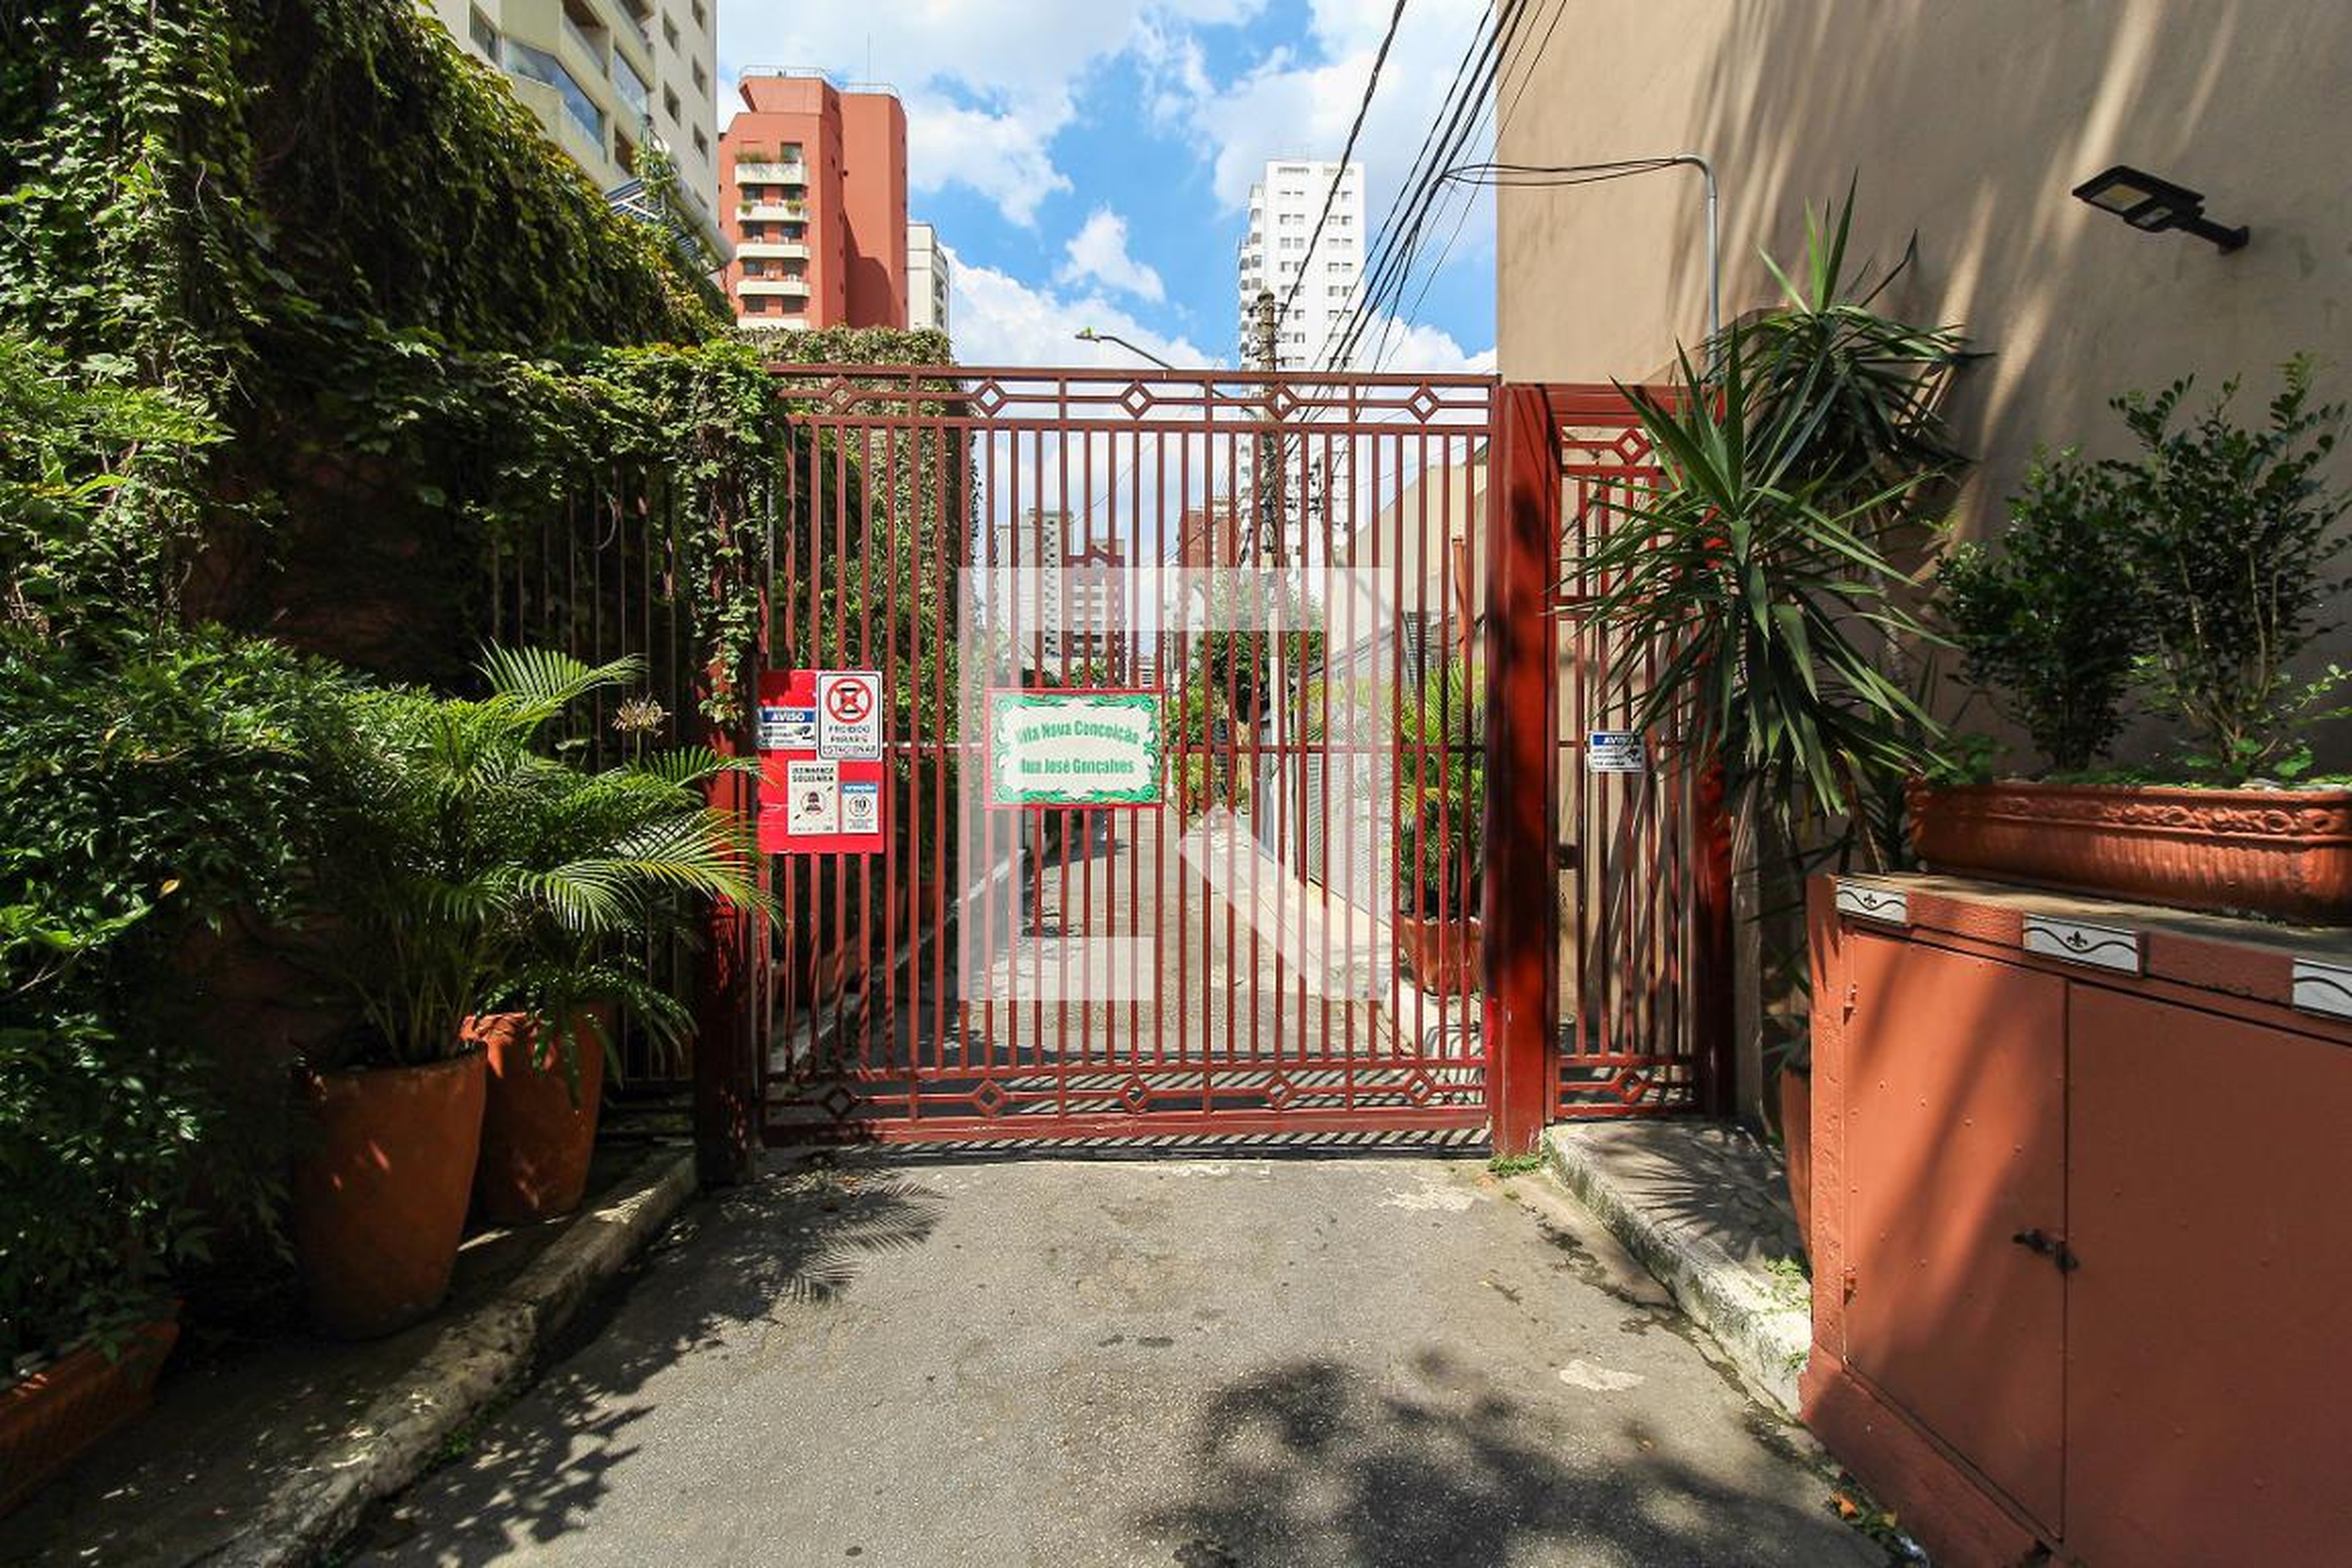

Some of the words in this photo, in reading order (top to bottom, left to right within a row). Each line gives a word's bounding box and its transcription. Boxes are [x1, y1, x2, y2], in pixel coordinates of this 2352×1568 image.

[771, 712, 805, 721] AVISO
[1042, 722, 1071, 739] Nova
[1044, 758, 1071, 774] José
[1072, 758, 1133, 775] Gonçalves
